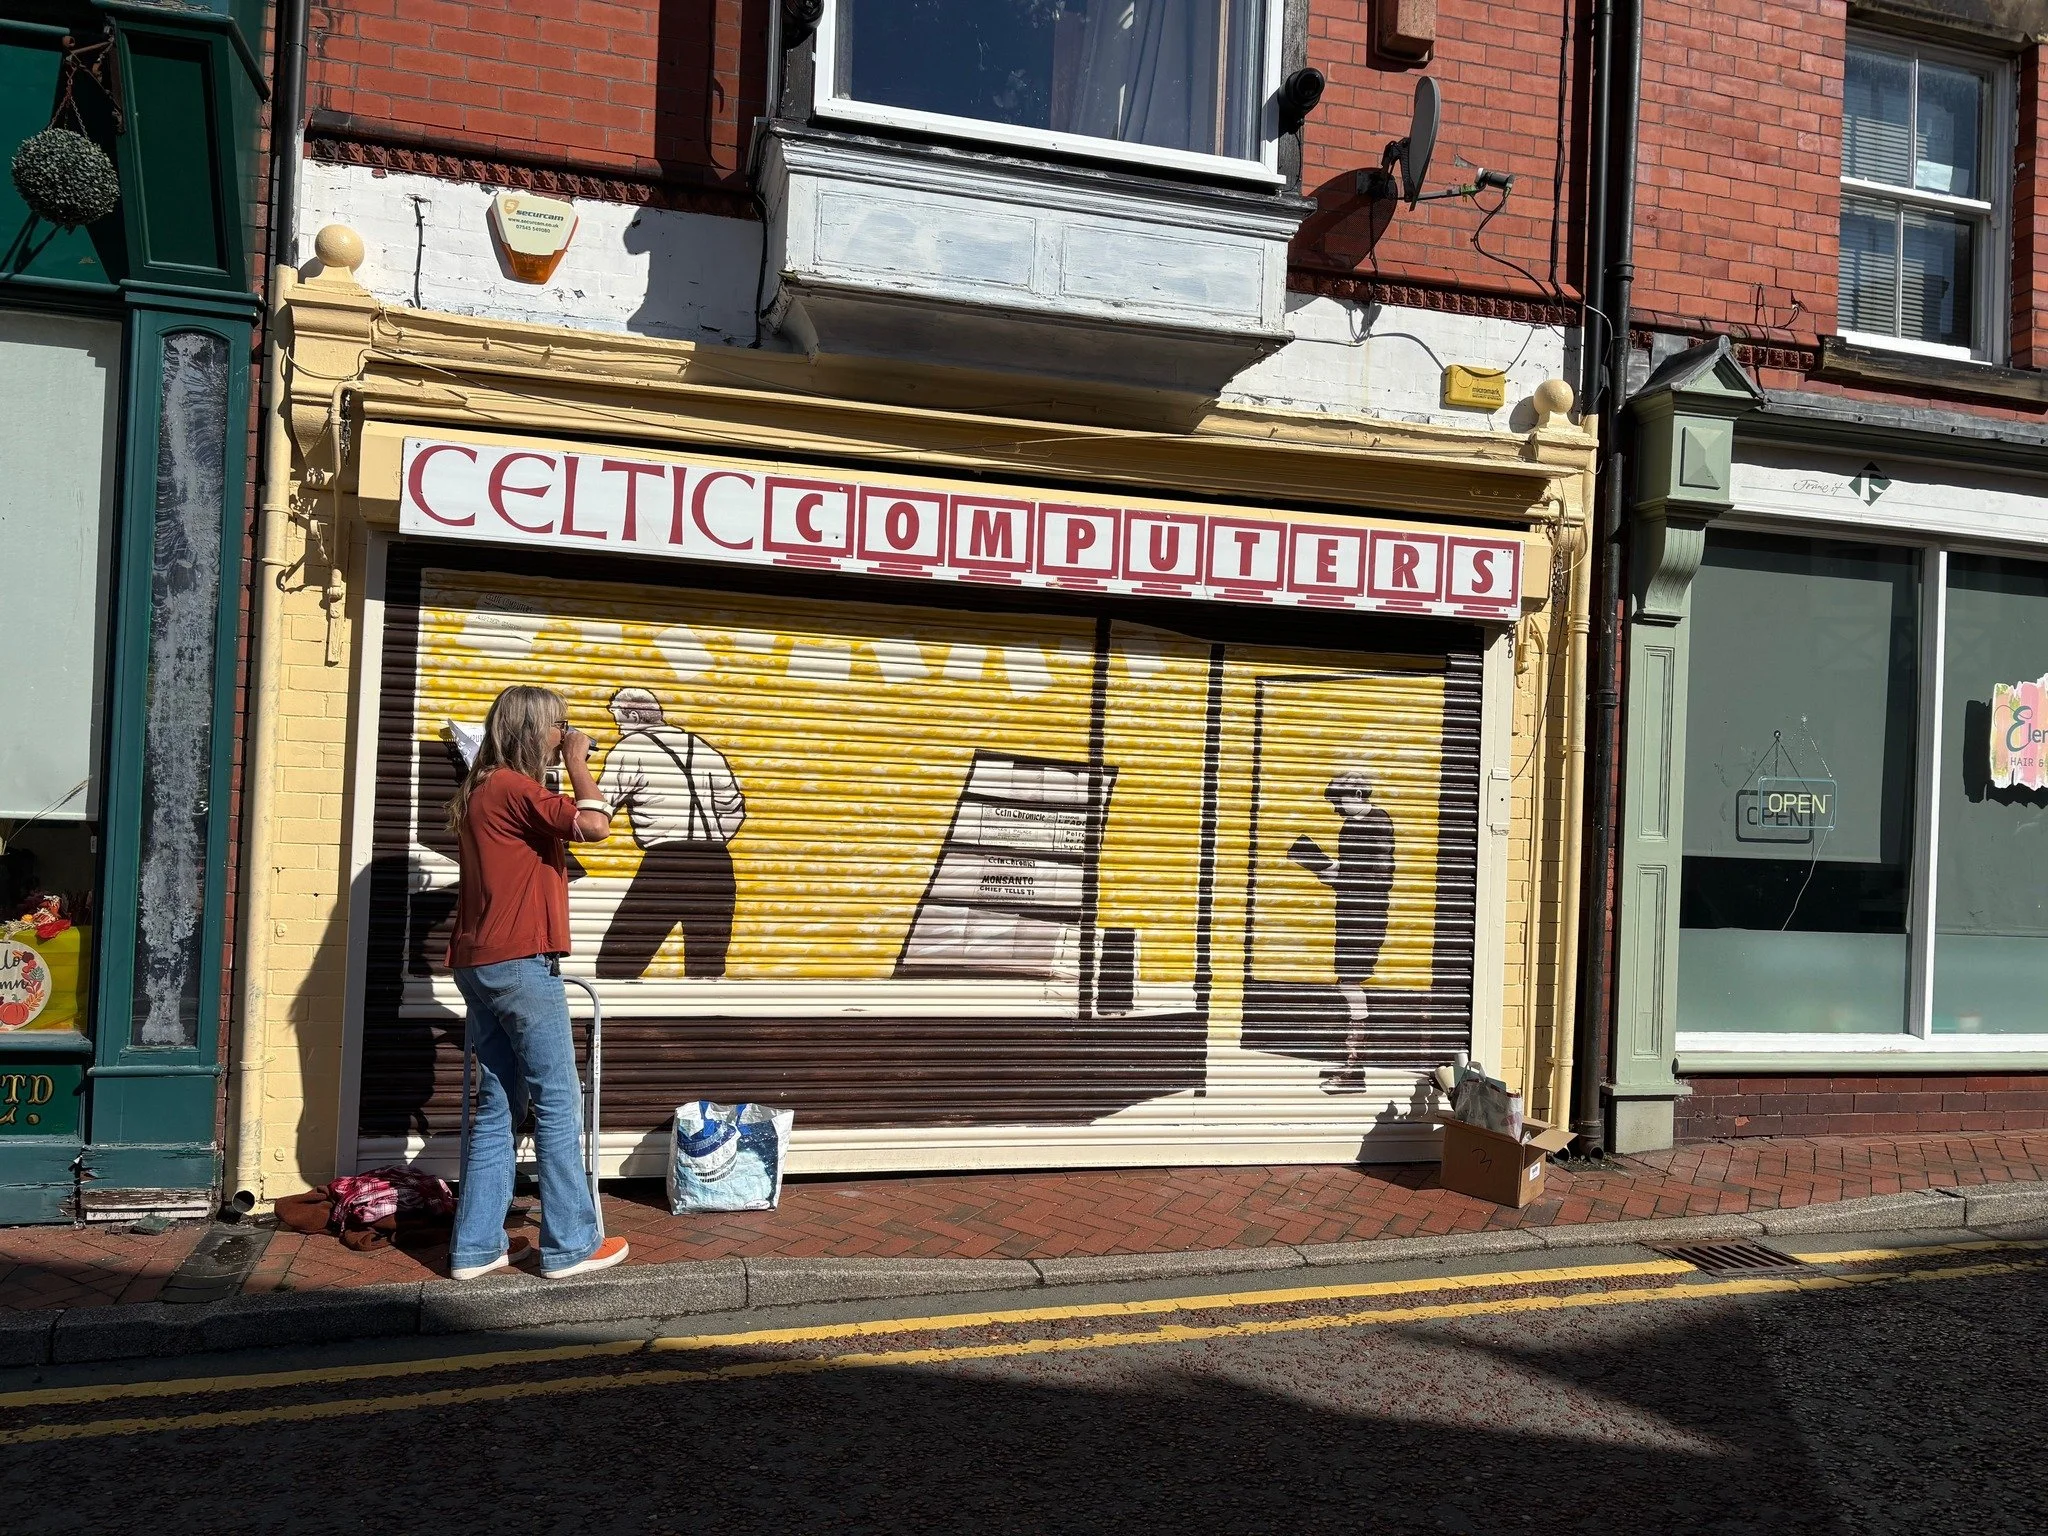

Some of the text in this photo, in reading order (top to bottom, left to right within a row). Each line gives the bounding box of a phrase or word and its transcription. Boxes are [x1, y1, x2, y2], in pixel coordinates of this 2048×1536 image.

[516, 209, 564, 221] securcam
[508, 217, 559, 228] www.securcam.co.uk
[408, 445, 1495, 595] CELTIC COMPUTERS
[2010, 757, 2034, 767] HAIR
[1768, 793, 1826, 814] OPEN
[981, 875, 1034, 885] MONSANTO
[0, 949, 20, 970] lo
